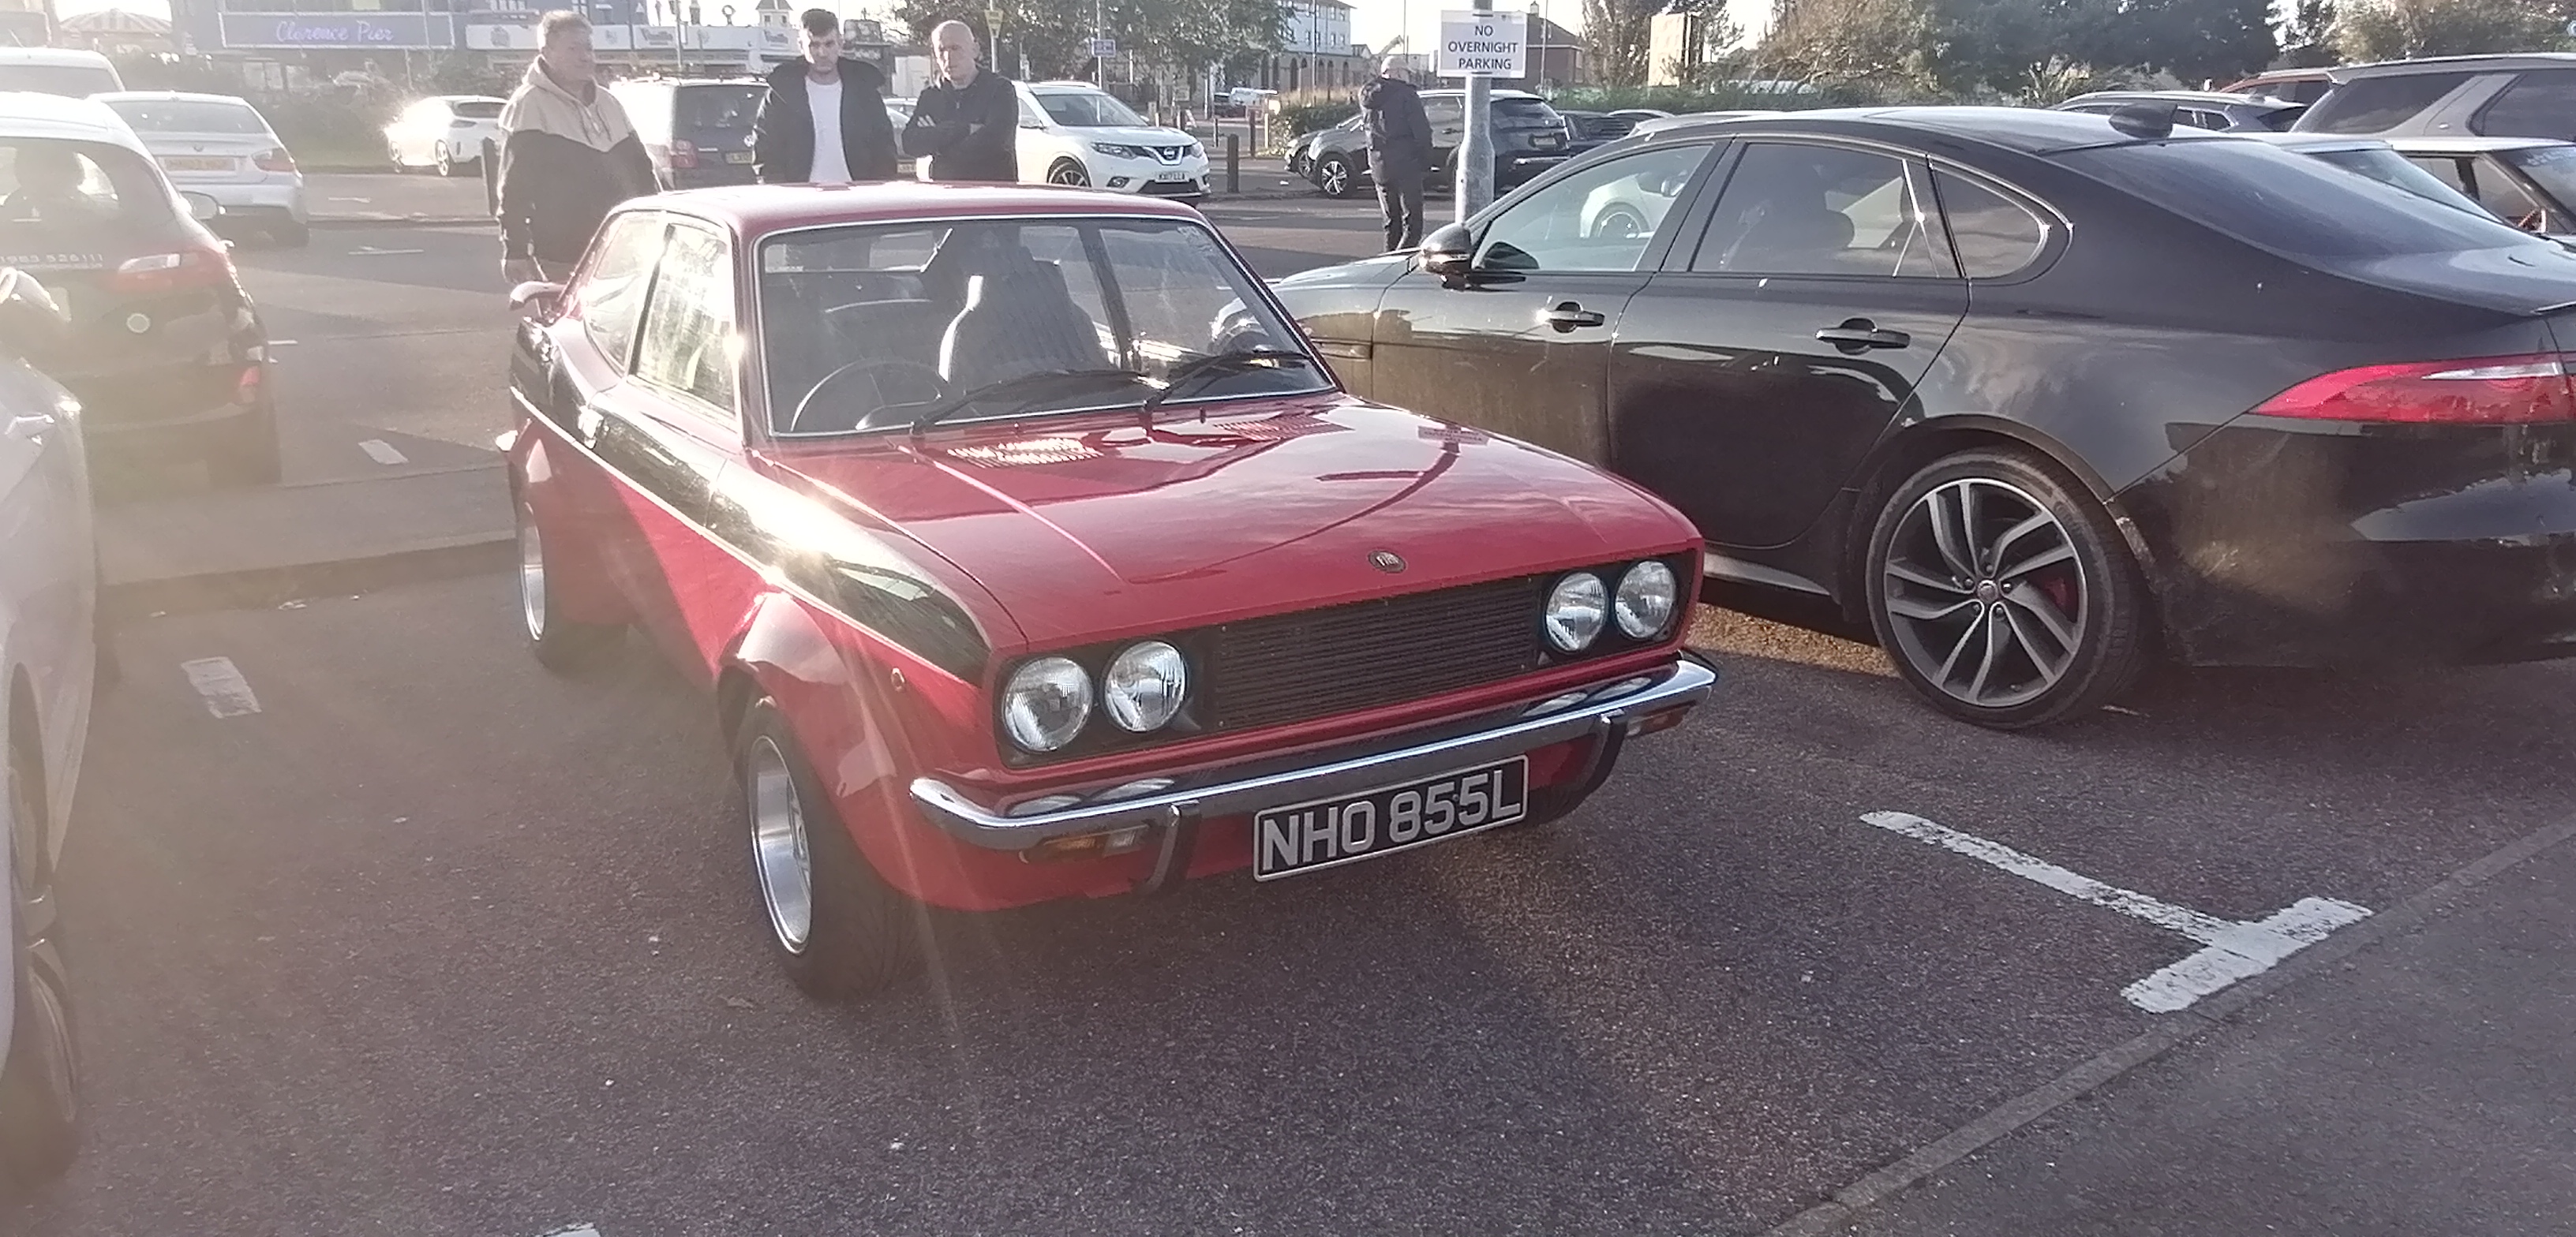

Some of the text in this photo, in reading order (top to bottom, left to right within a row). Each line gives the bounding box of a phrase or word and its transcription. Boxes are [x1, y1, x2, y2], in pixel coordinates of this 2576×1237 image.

[276, 20, 395, 42] Clarence Pier
[1474, 25, 1493, 36] NO
[1447, 41, 1518, 53] OVERNIGHT
[1458, 58, 1512, 69] PARKING
[1263, 770, 1521, 871] NHO 855L
